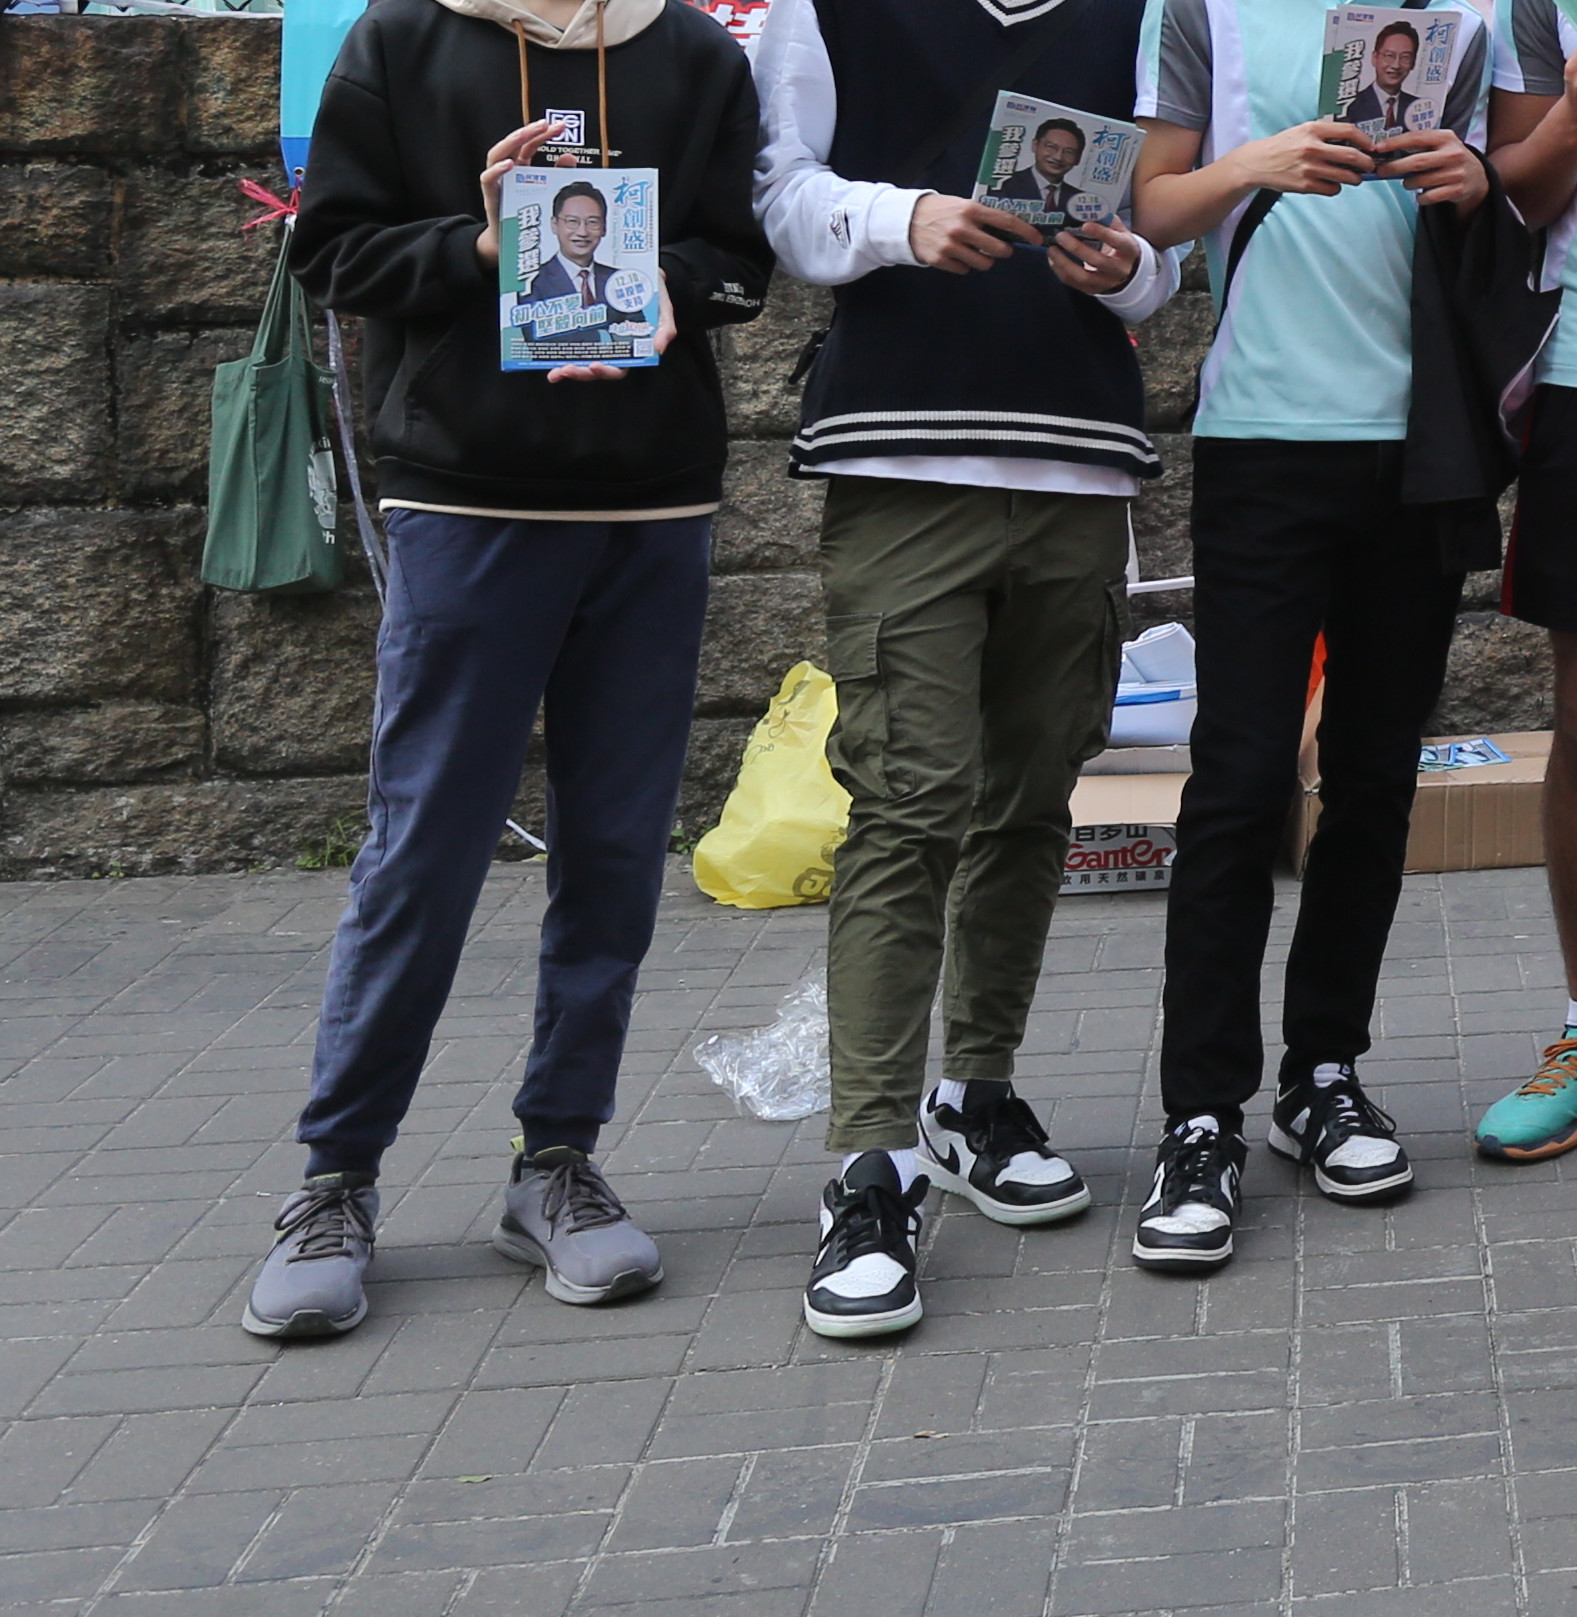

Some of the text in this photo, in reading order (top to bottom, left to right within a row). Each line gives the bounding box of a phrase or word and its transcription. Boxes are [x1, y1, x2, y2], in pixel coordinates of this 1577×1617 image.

[1425, 19, 1454, 82] 柯創盛
[1092, 126, 1126, 182] 柯創盛
[613, 177, 649, 251] 柯創盛
[615, 273, 639, 284] 12.10
[512, 294, 582, 325] 初心不變
